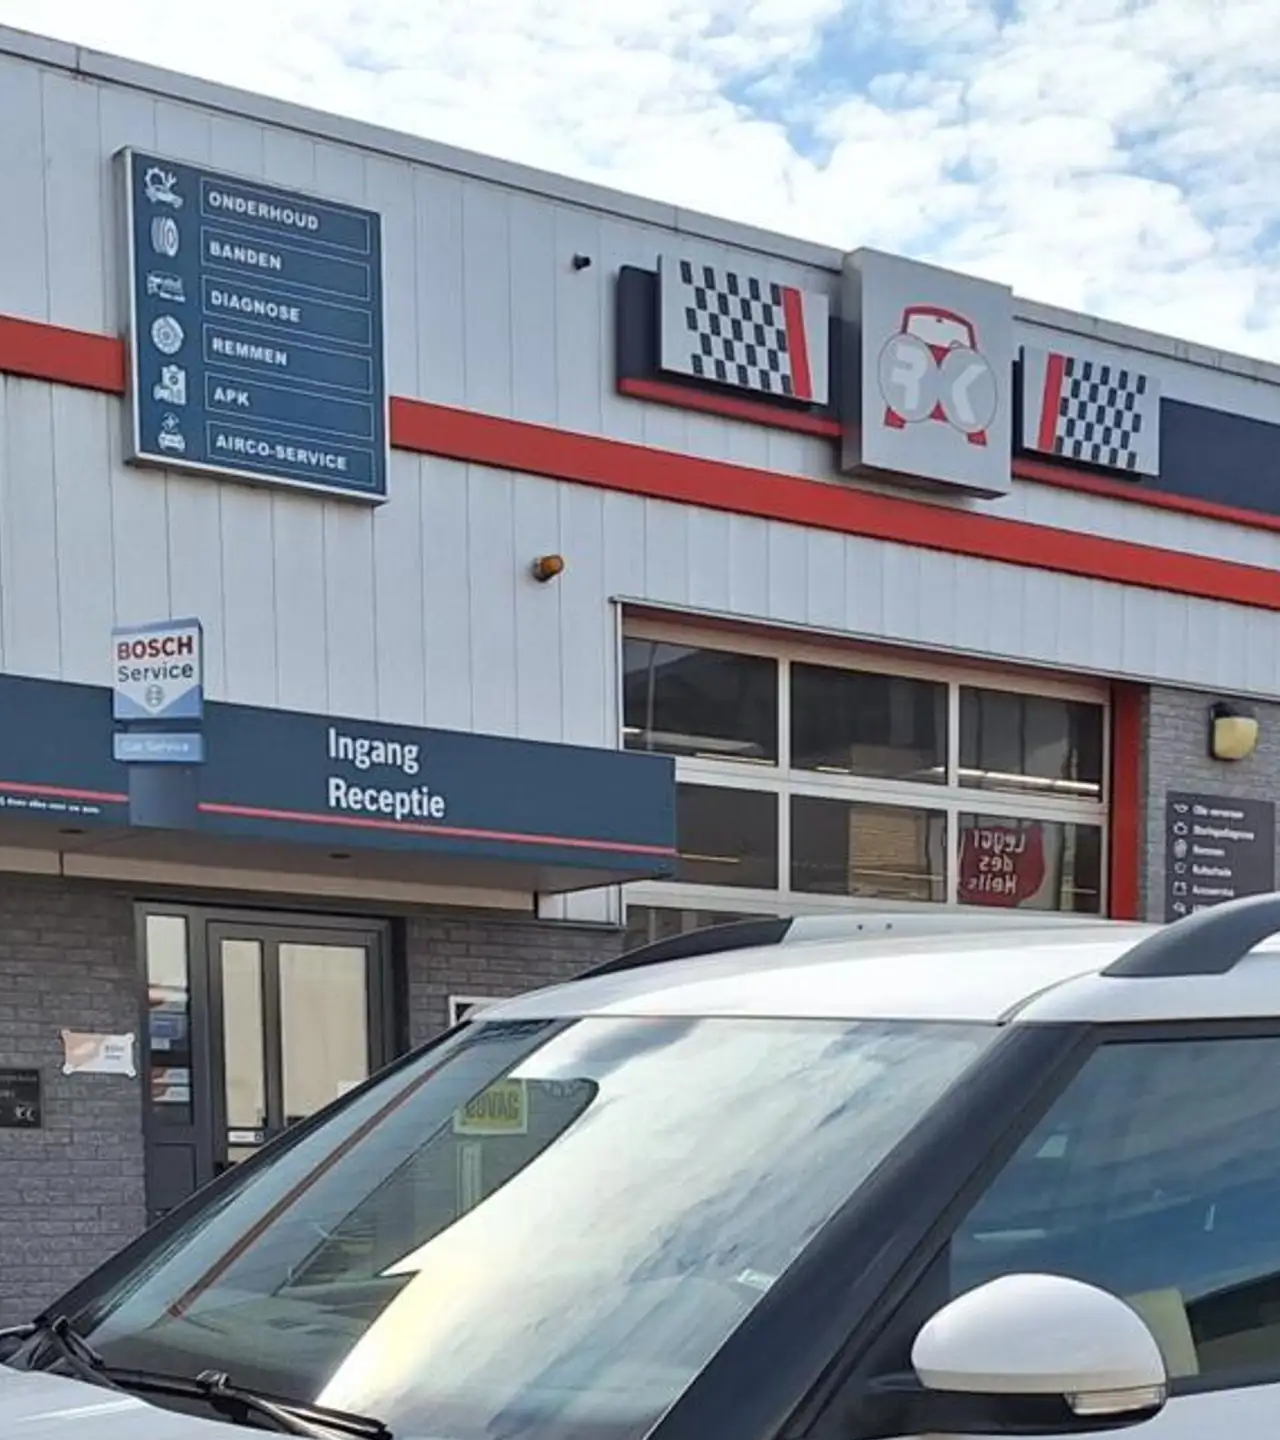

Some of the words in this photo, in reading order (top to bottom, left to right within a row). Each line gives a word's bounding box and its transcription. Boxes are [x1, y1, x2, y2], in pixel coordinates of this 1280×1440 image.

[209, 191, 319, 230] ONDERHOUD
[210, 241, 281, 270] BANDEN
[211, 290, 301, 322] DIAGNOSE
[213, 338, 287, 366] REMMEN
[214, 387, 249, 406] APK
[216, 435, 348, 470] AIRCO-SERVICE
[117, 635, 193, 660] BOSCH
[118, 662, 194, 682] Service
[327, 727, 419, 774] Ingang
[328, 777, 446, 820] Receptie
